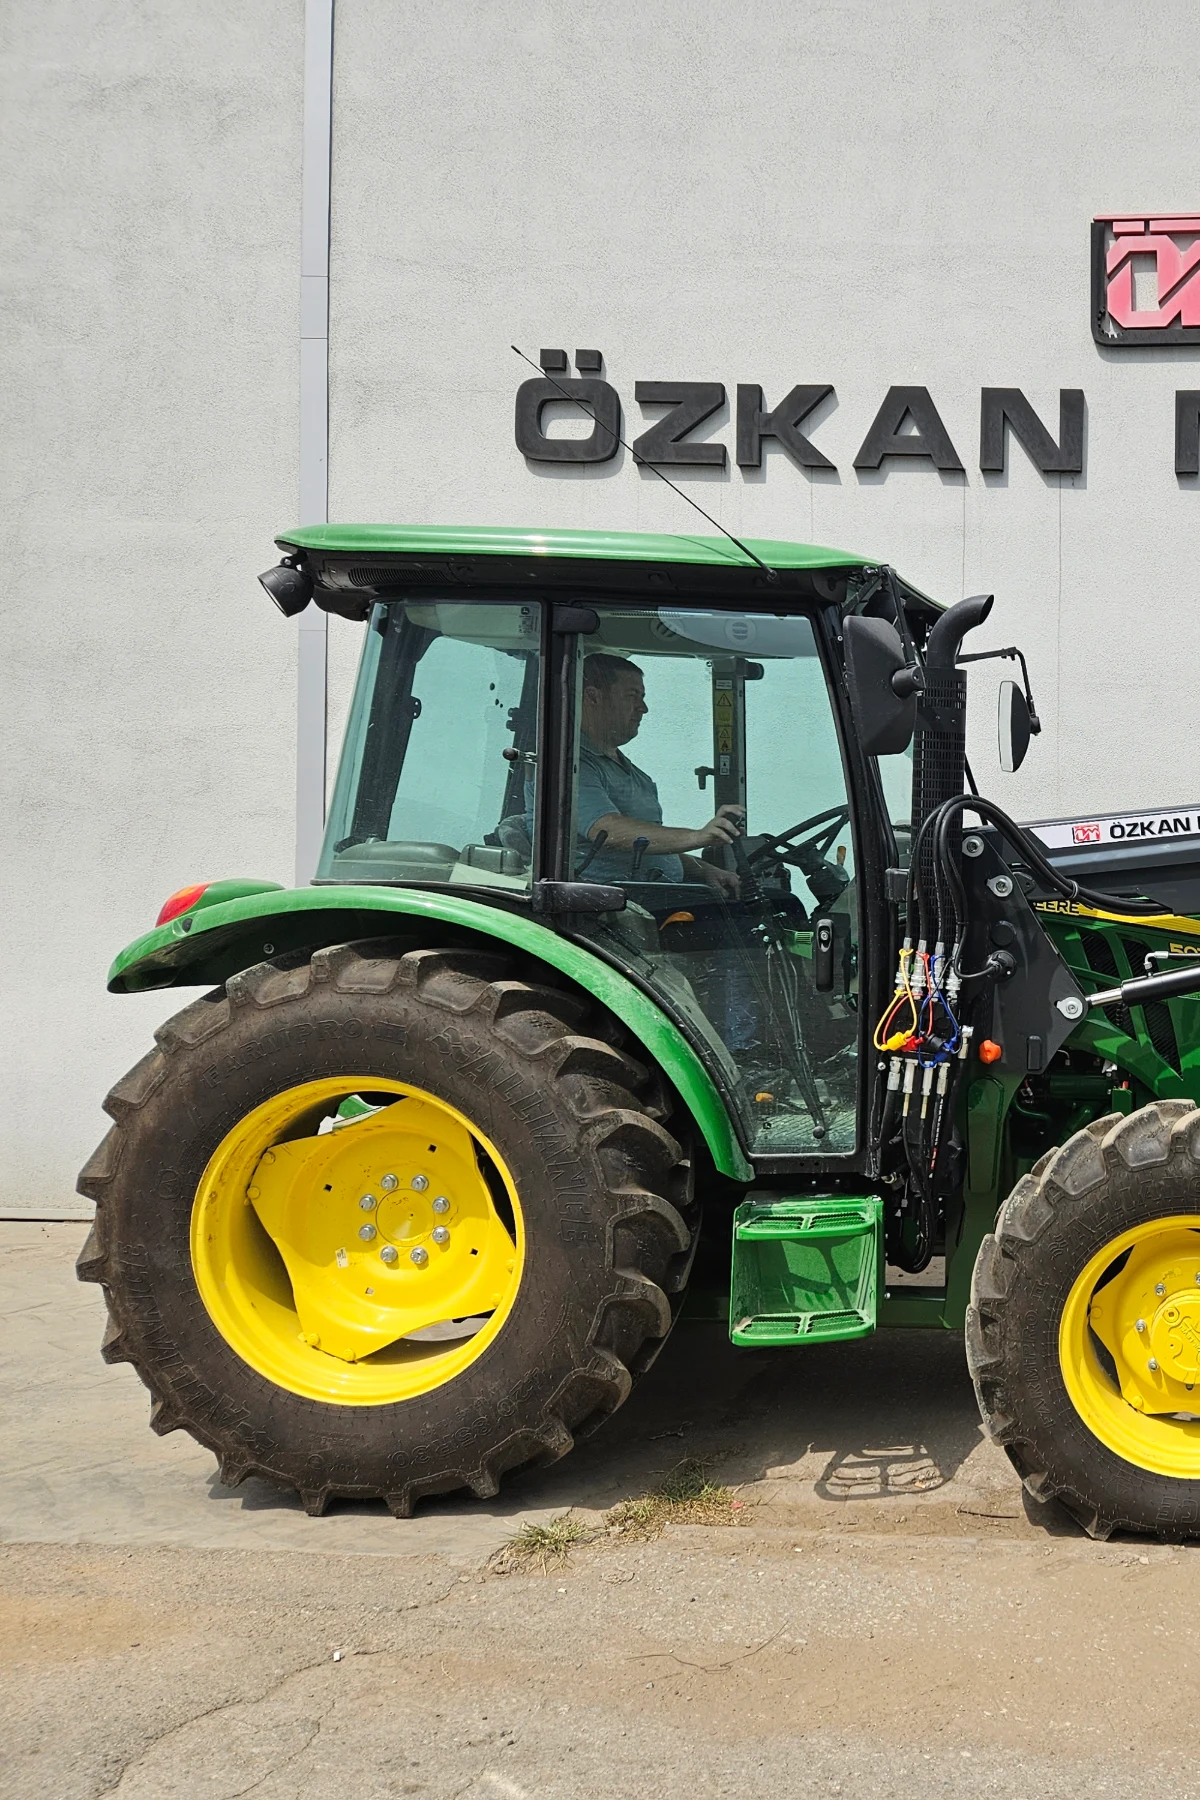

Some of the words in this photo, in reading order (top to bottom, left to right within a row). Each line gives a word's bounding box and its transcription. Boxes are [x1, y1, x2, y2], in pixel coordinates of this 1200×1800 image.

[515, 348, 1084, 474] ÖZKAN
[1109, 816, 1191, 839] ÖZKAN
[456, 1050, 597, 1242] ALLIANCE
